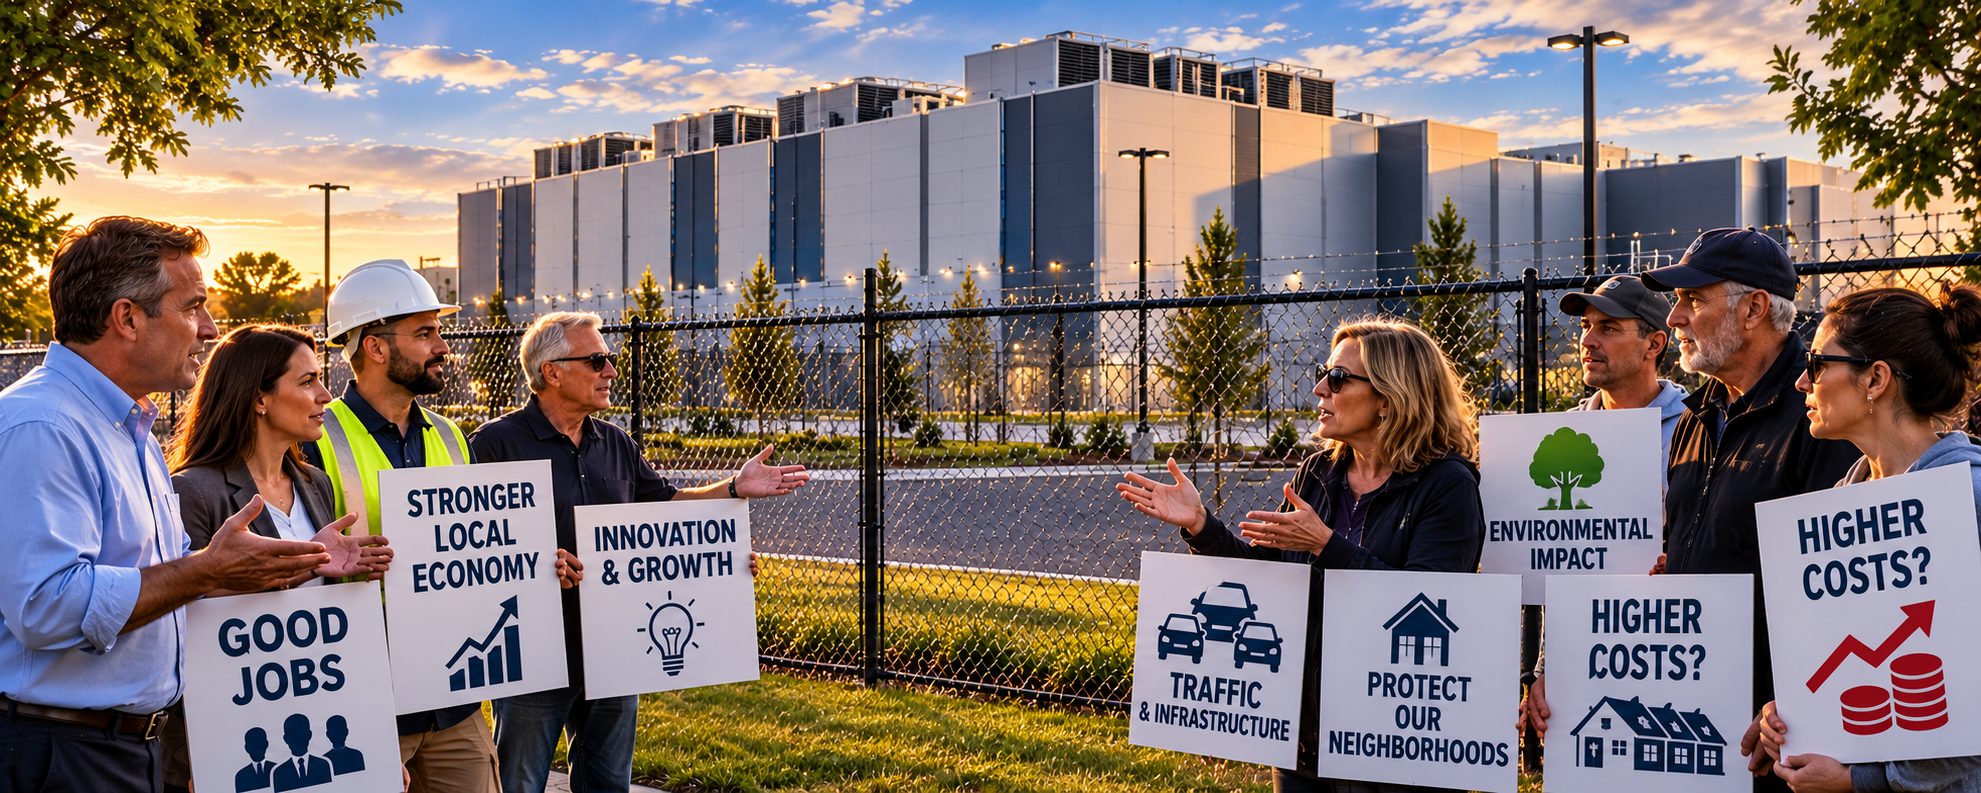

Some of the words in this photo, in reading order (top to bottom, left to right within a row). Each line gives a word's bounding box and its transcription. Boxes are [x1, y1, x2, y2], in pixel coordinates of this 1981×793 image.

[408, 482, 535, 517] STRONGER
[435, 519, 516, 552] LOCAL
[595, 519, 736, 551] INNOVATION
[1490, 518, 1653, 542] ENVIRONMENTAL
[1798, 499, 1927, 554] HIGHER
[413, 552, 539, 593] ECONOMY
[602, 559, 620, 585] &
[628, 551, 732, 583] GROWTH
[1531, 547, 1607, 570] IMPACT
[1803, 546, 1930, 600] COSTS?
[218, 607, 348, 657] GOOD
[1592, 599, 1702, 633] HIGHER
[232, 654, 345, 705] JOBS
[1589, 644, 1706, 681] COSTS?
[1171, 672, 1262, 709] TRAFFIC
[1368, 672, 1471, 702] PROTECT
[1139, 701, 1149, 721] &
[1155, 703, 1290, 741] INFRASTRUCTURE
[1395, 705, 1441, 731] OUR
[1329, 731, 1508, 767] NEIGHBORHOODS
